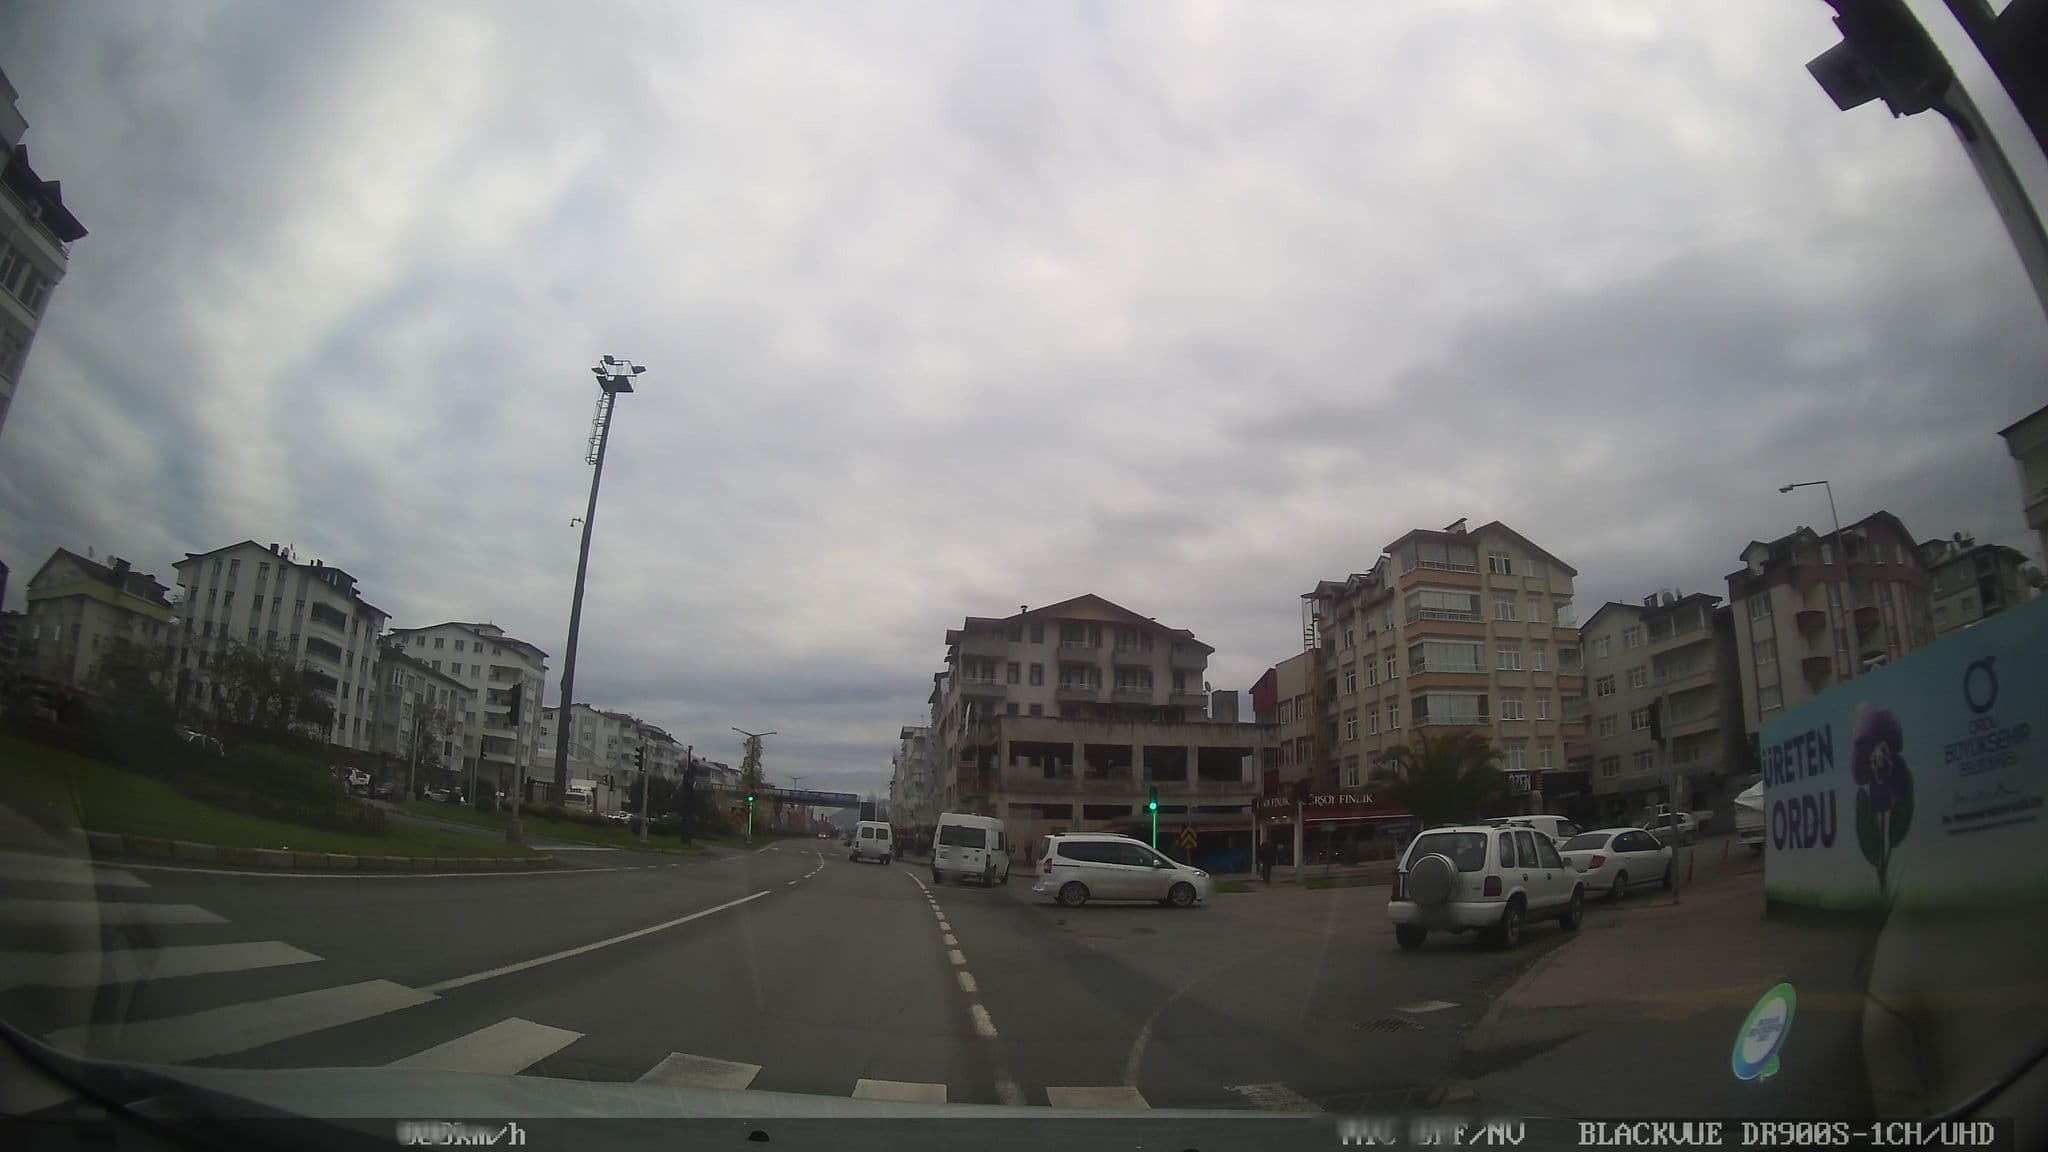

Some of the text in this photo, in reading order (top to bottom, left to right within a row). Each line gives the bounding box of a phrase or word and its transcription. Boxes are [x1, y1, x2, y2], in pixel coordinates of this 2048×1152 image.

[1761, 723, 1834, 789] ÜRETEN
[1308, 793, 1373, 807] RSOY FINIK
[1772, 789, 1837, 851] ORDU
